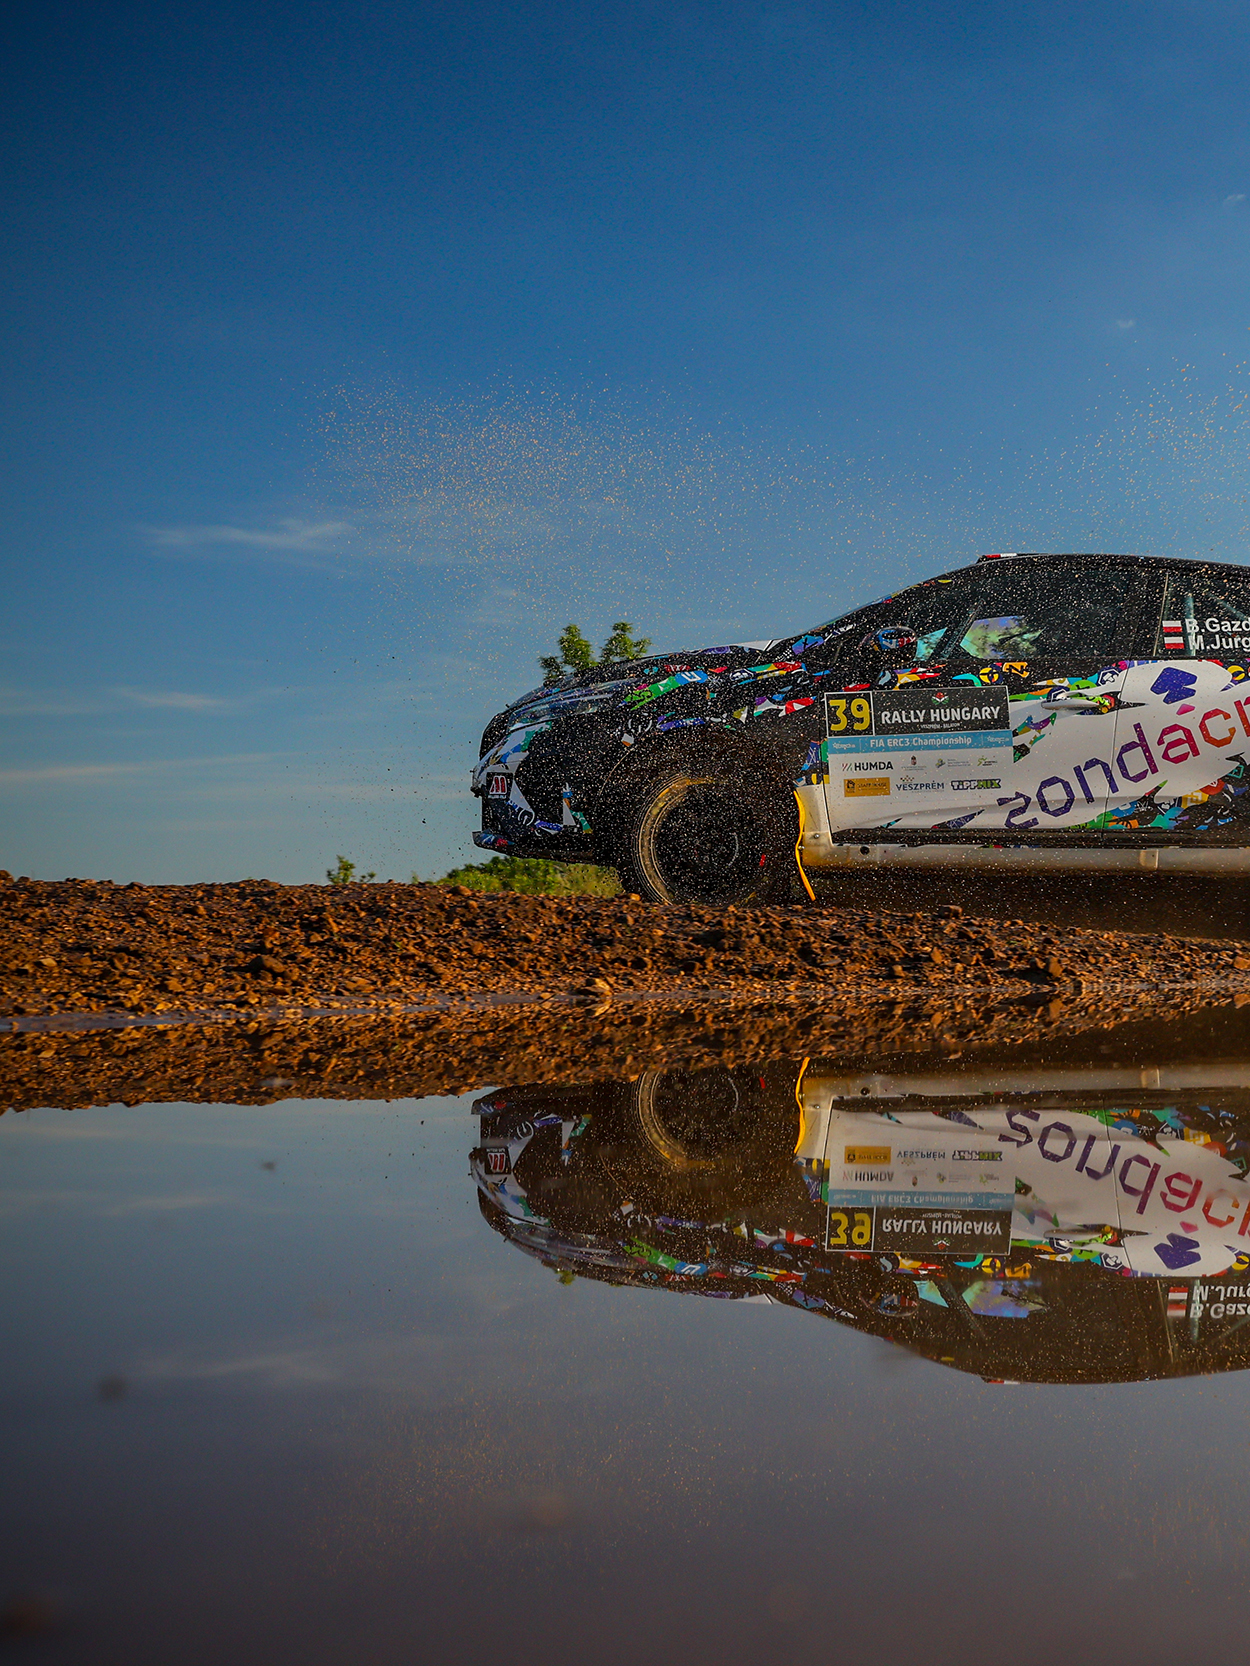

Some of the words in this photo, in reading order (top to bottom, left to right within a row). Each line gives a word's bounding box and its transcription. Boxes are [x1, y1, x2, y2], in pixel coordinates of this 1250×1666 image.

[829, 698, 871, 731] 39
[881, 709, 926, 724] RALLY
[930, 706, 1000, 721] HUNGARY
[870, 739, 884, 748] FIA
[887, 738, 910, 747] ERC3
[912, 736, 972, 747] Championship
[854, 761, 894, 771] HUMDA
[896, 780, 945, 791] VESZPRÉM
